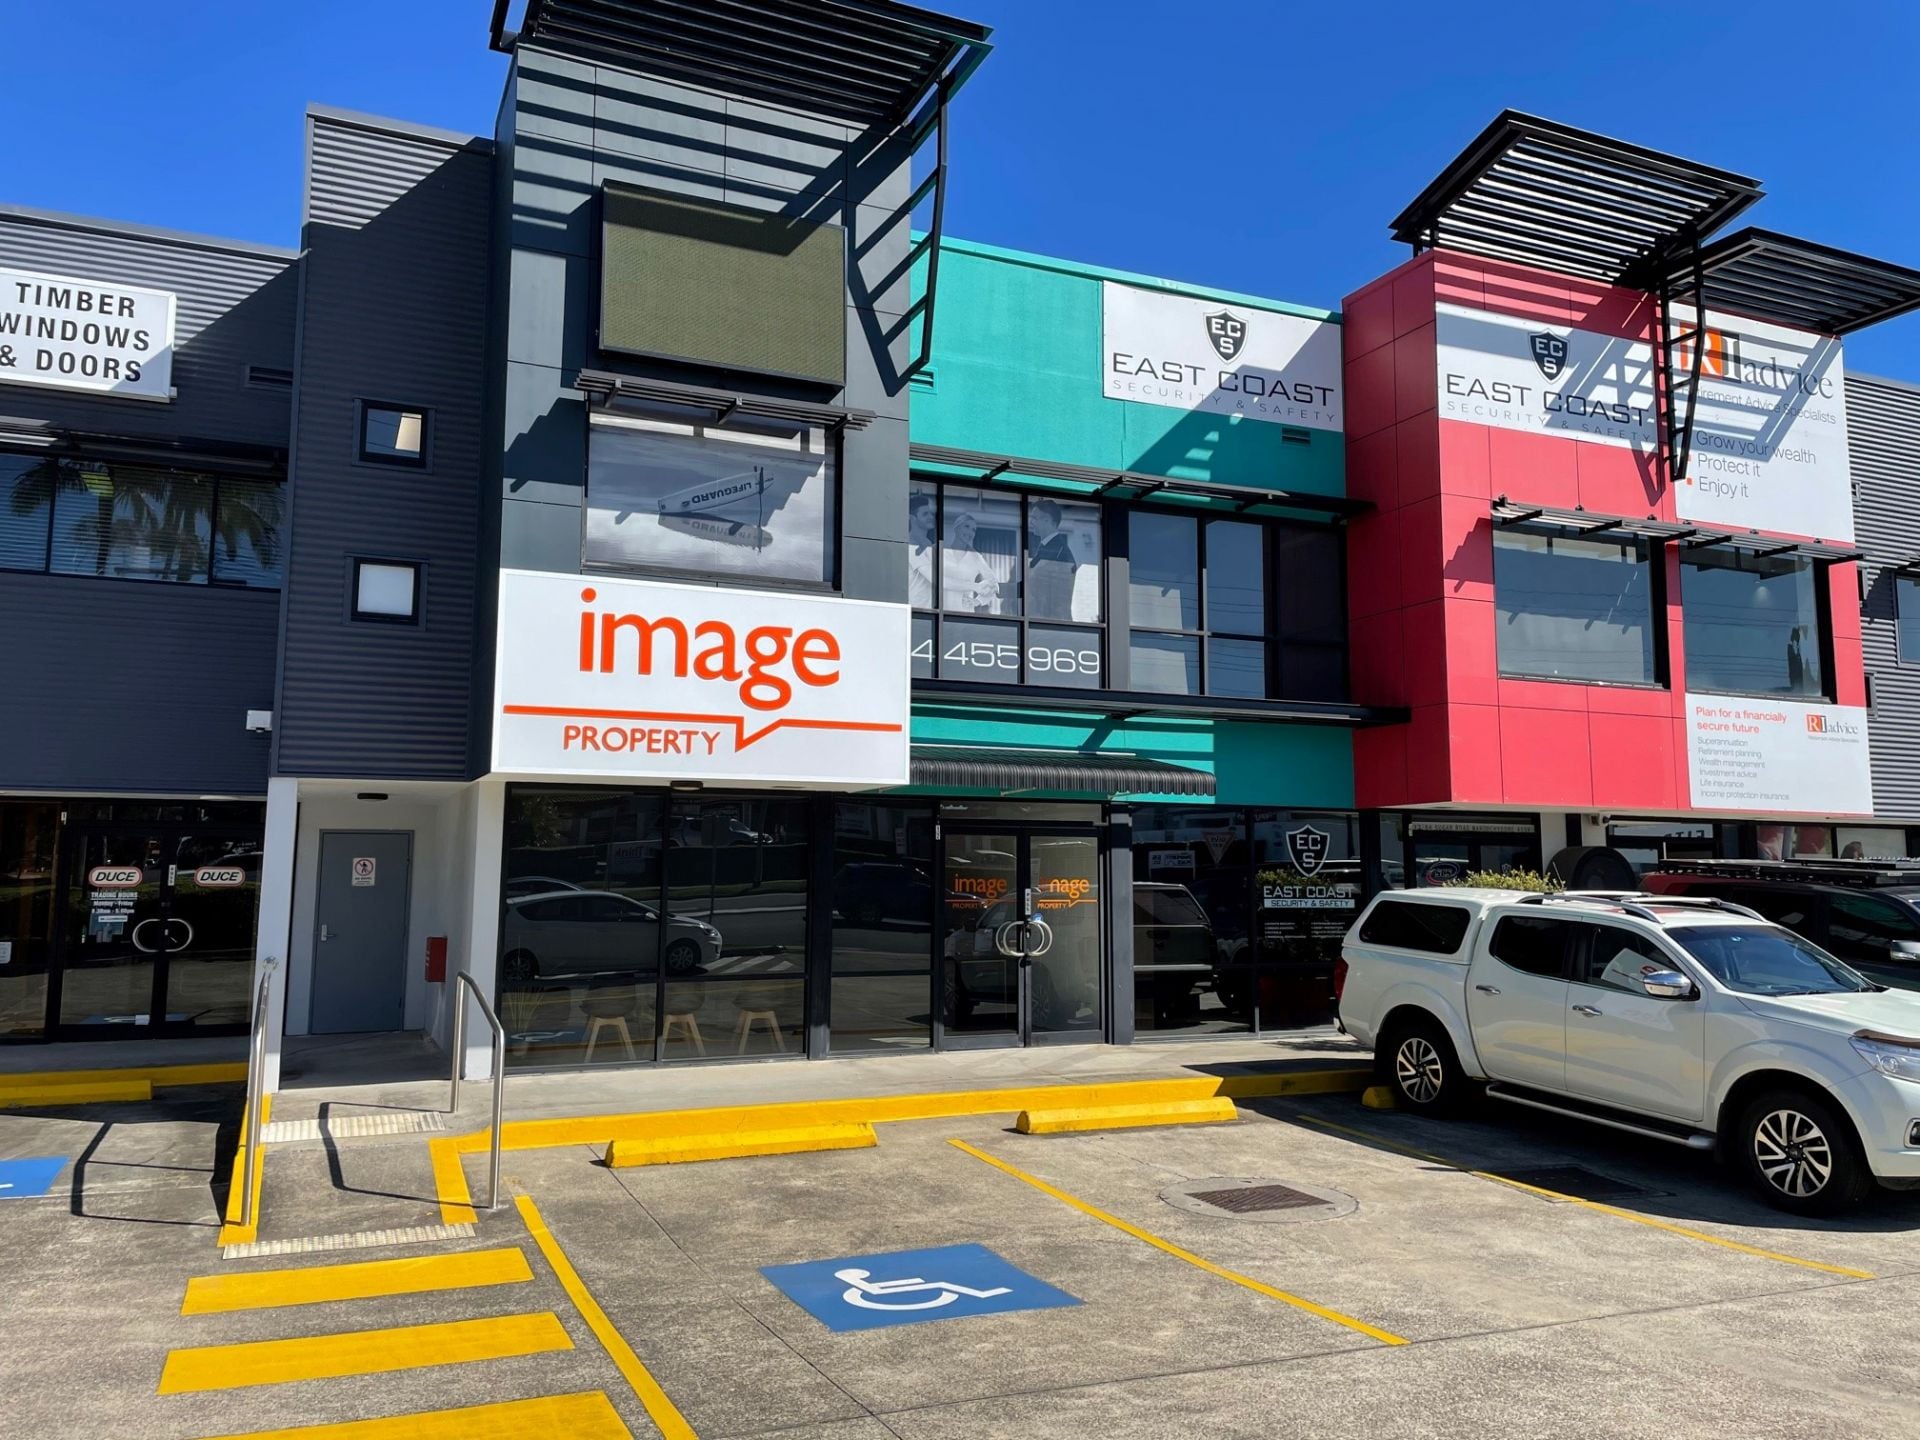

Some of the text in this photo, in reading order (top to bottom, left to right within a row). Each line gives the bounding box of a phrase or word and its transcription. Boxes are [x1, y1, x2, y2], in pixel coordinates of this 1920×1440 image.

[16, 282, 135, 318] TIMBER
[0, 312, 150, 351] WINDOWS
[0, 344, 142, 382] & DOORS
[1112, 352, 1335, 407] EAST COAST
[1112, 379, 1336, 423] SECURITY & SAFETY
[1446, 373, 1650, 427] EAST COAST
[1745, 394, 1781, 414] Advice
[1783, 404, 1837, 425] Specialists
[1447, 401, 1651, 442] SECURITY & SAFETY
[1696, 430, 1817, 465] Grow your wealth
[1697, 453, 1761, 477] Protect it
[691, 481, 752, 504] LIFEGUARD
[1699, 476, 1749, 499] Enjoy it
[579, 587, 841, 711] image
[943, 641, 1019, 669] 455
[1028, 646, 1100, 674] 969
[1696, 706, 1787, 724] Plan for a financially
[1697, 722, 1760, 733] secure future
[563, 725, 720, 755] PROPERTY
[1697, 736, 1749, 747] Superannuation
[1698, 747, 1762, 760] Retirement planning
[1698, 757, 1765, 769] Wealth management
[1699, 768, 1757, 778] Investment advice
[1700, 778, 1745, 788] Life insurance
[1701, 790, 1790, 800] Income protection insurance
[95, 871, 137, 882] DUCE
[200, 871, 240, 882] DUCE
[954, 873, 1007, 898] image
[1041, 878, 1090, 899] mage
[1263, 885, 1353, 898] EAST COAST
